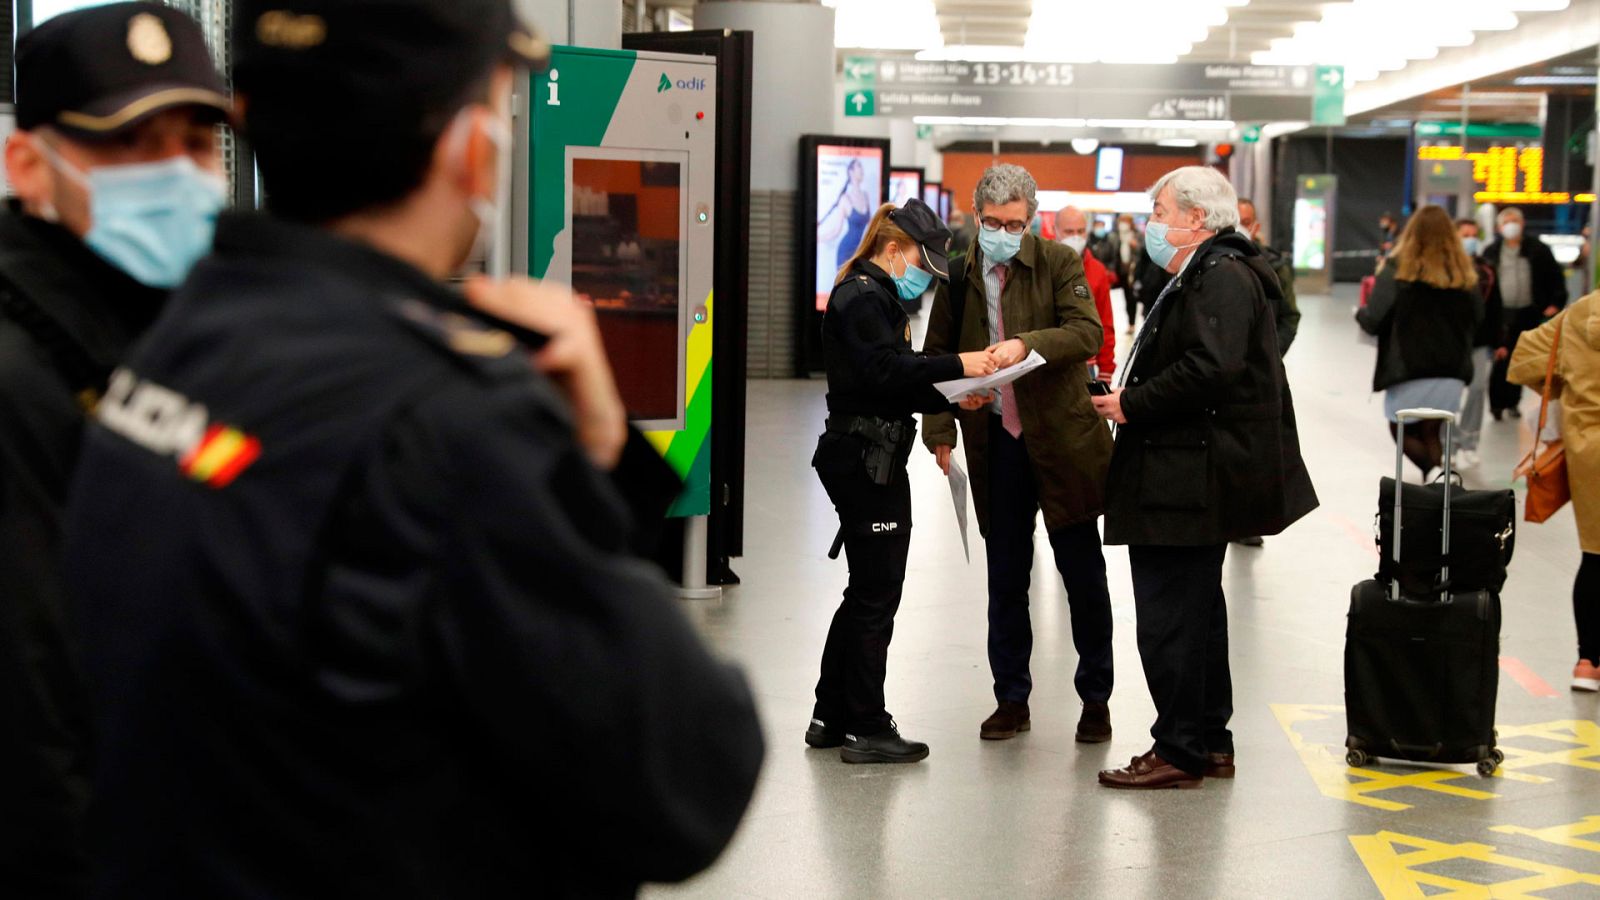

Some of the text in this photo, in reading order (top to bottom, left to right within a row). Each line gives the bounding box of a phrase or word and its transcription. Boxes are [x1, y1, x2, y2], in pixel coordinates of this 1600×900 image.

[547, 68, 560, 105] i
[676, 77, 706, 91] adif
[872, 522, 898, 532] CNP
